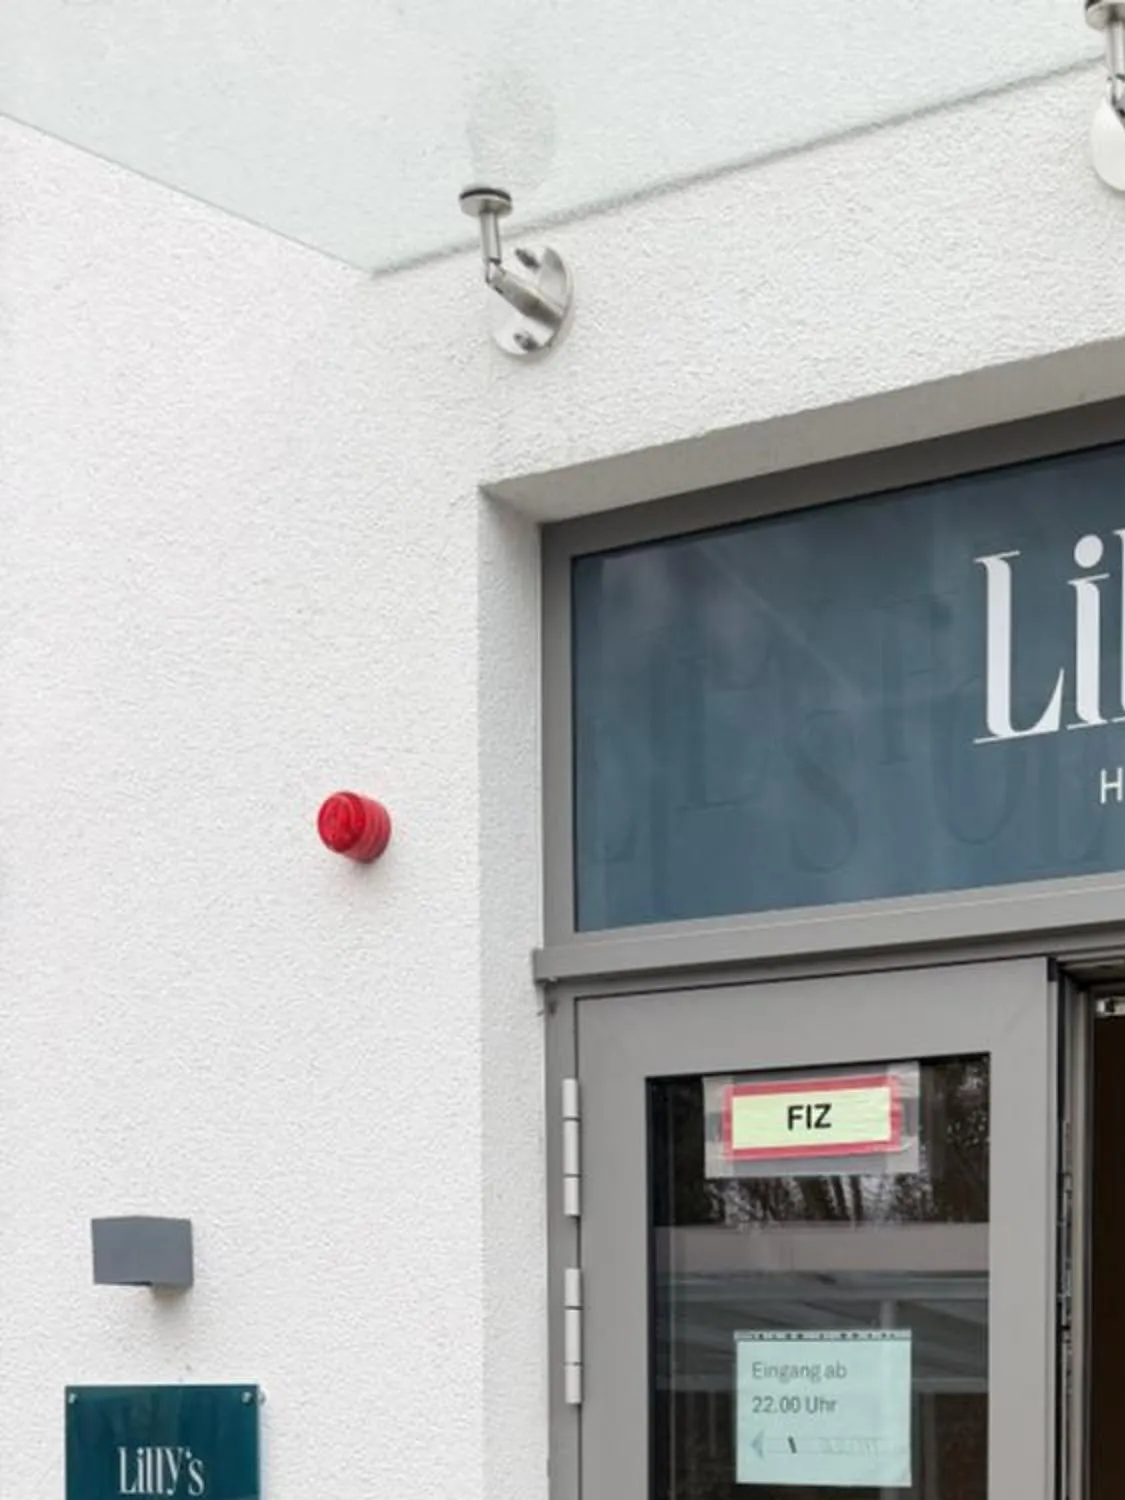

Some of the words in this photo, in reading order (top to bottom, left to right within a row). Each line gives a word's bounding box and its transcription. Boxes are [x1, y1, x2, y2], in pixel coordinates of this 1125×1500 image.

[786, 1103, 832, 1131] FIZ
[751, 1361, 822, 1383] Eingang
[824, 1361, 847, 1379] ab
[751, 1396, 801, 1414] 22.00
[805, 1396, 837, 1414] Uhr
[117, 1446, 205, 1496] Lilly's
